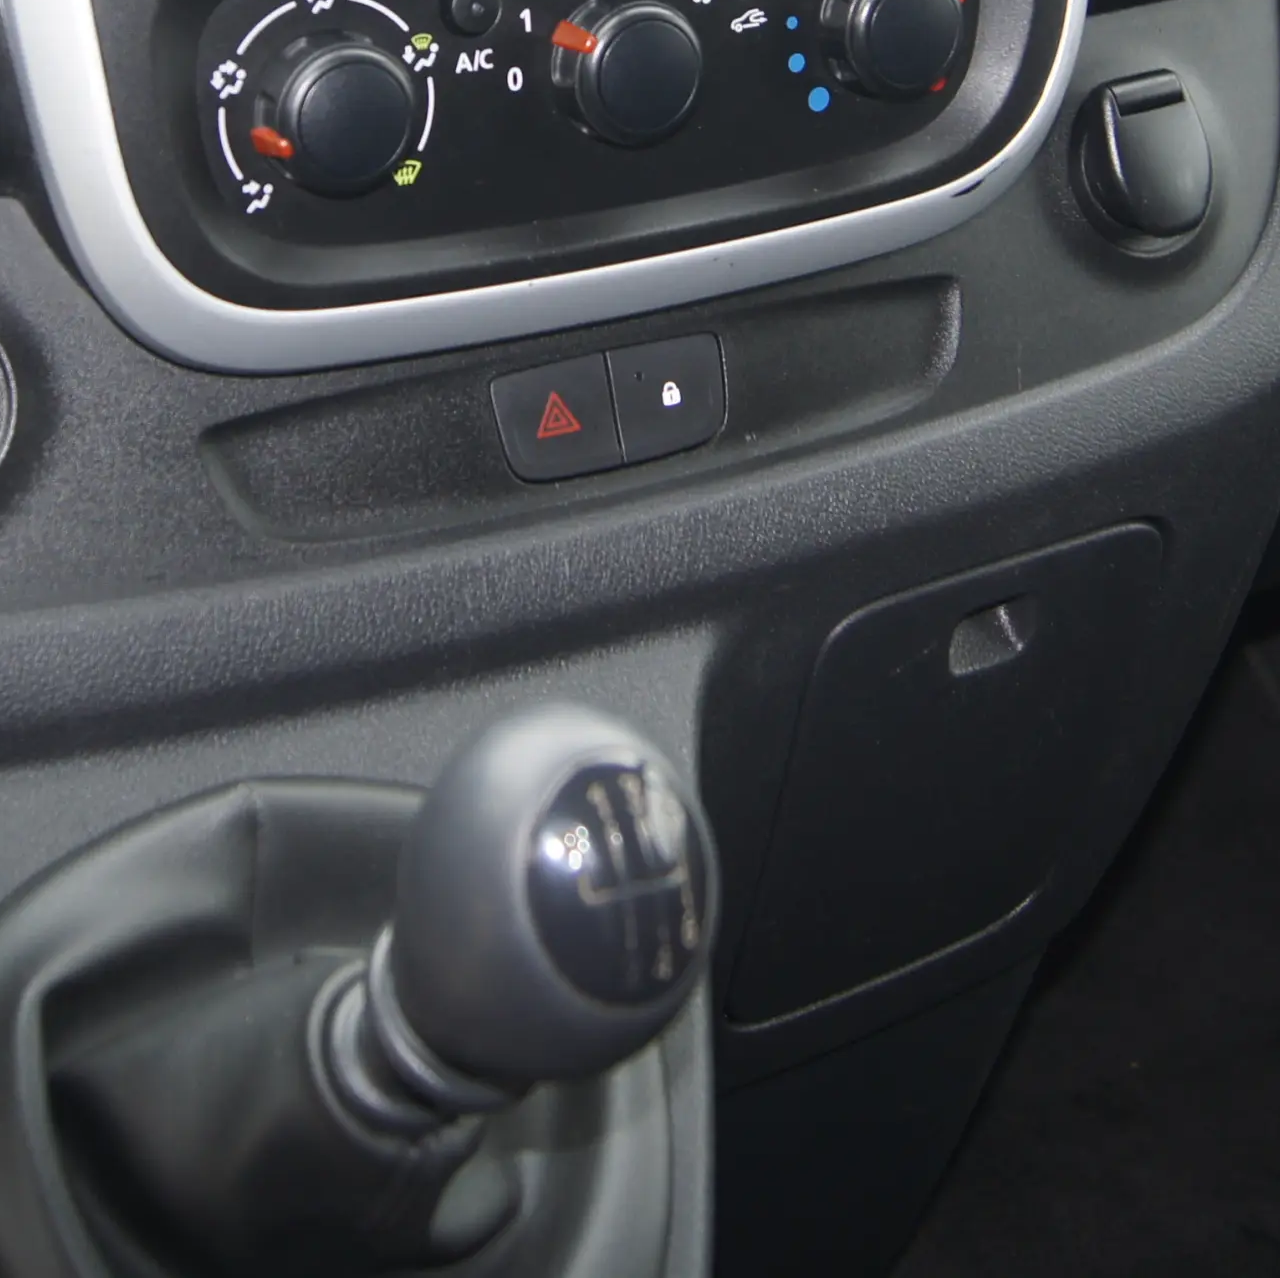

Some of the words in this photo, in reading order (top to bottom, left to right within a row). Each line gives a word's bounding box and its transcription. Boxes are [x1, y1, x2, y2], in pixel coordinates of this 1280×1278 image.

[519, 8, 532, 33] 1
[455, 48, 495, 74] A/C
[506, 66, 524, 92] 0
